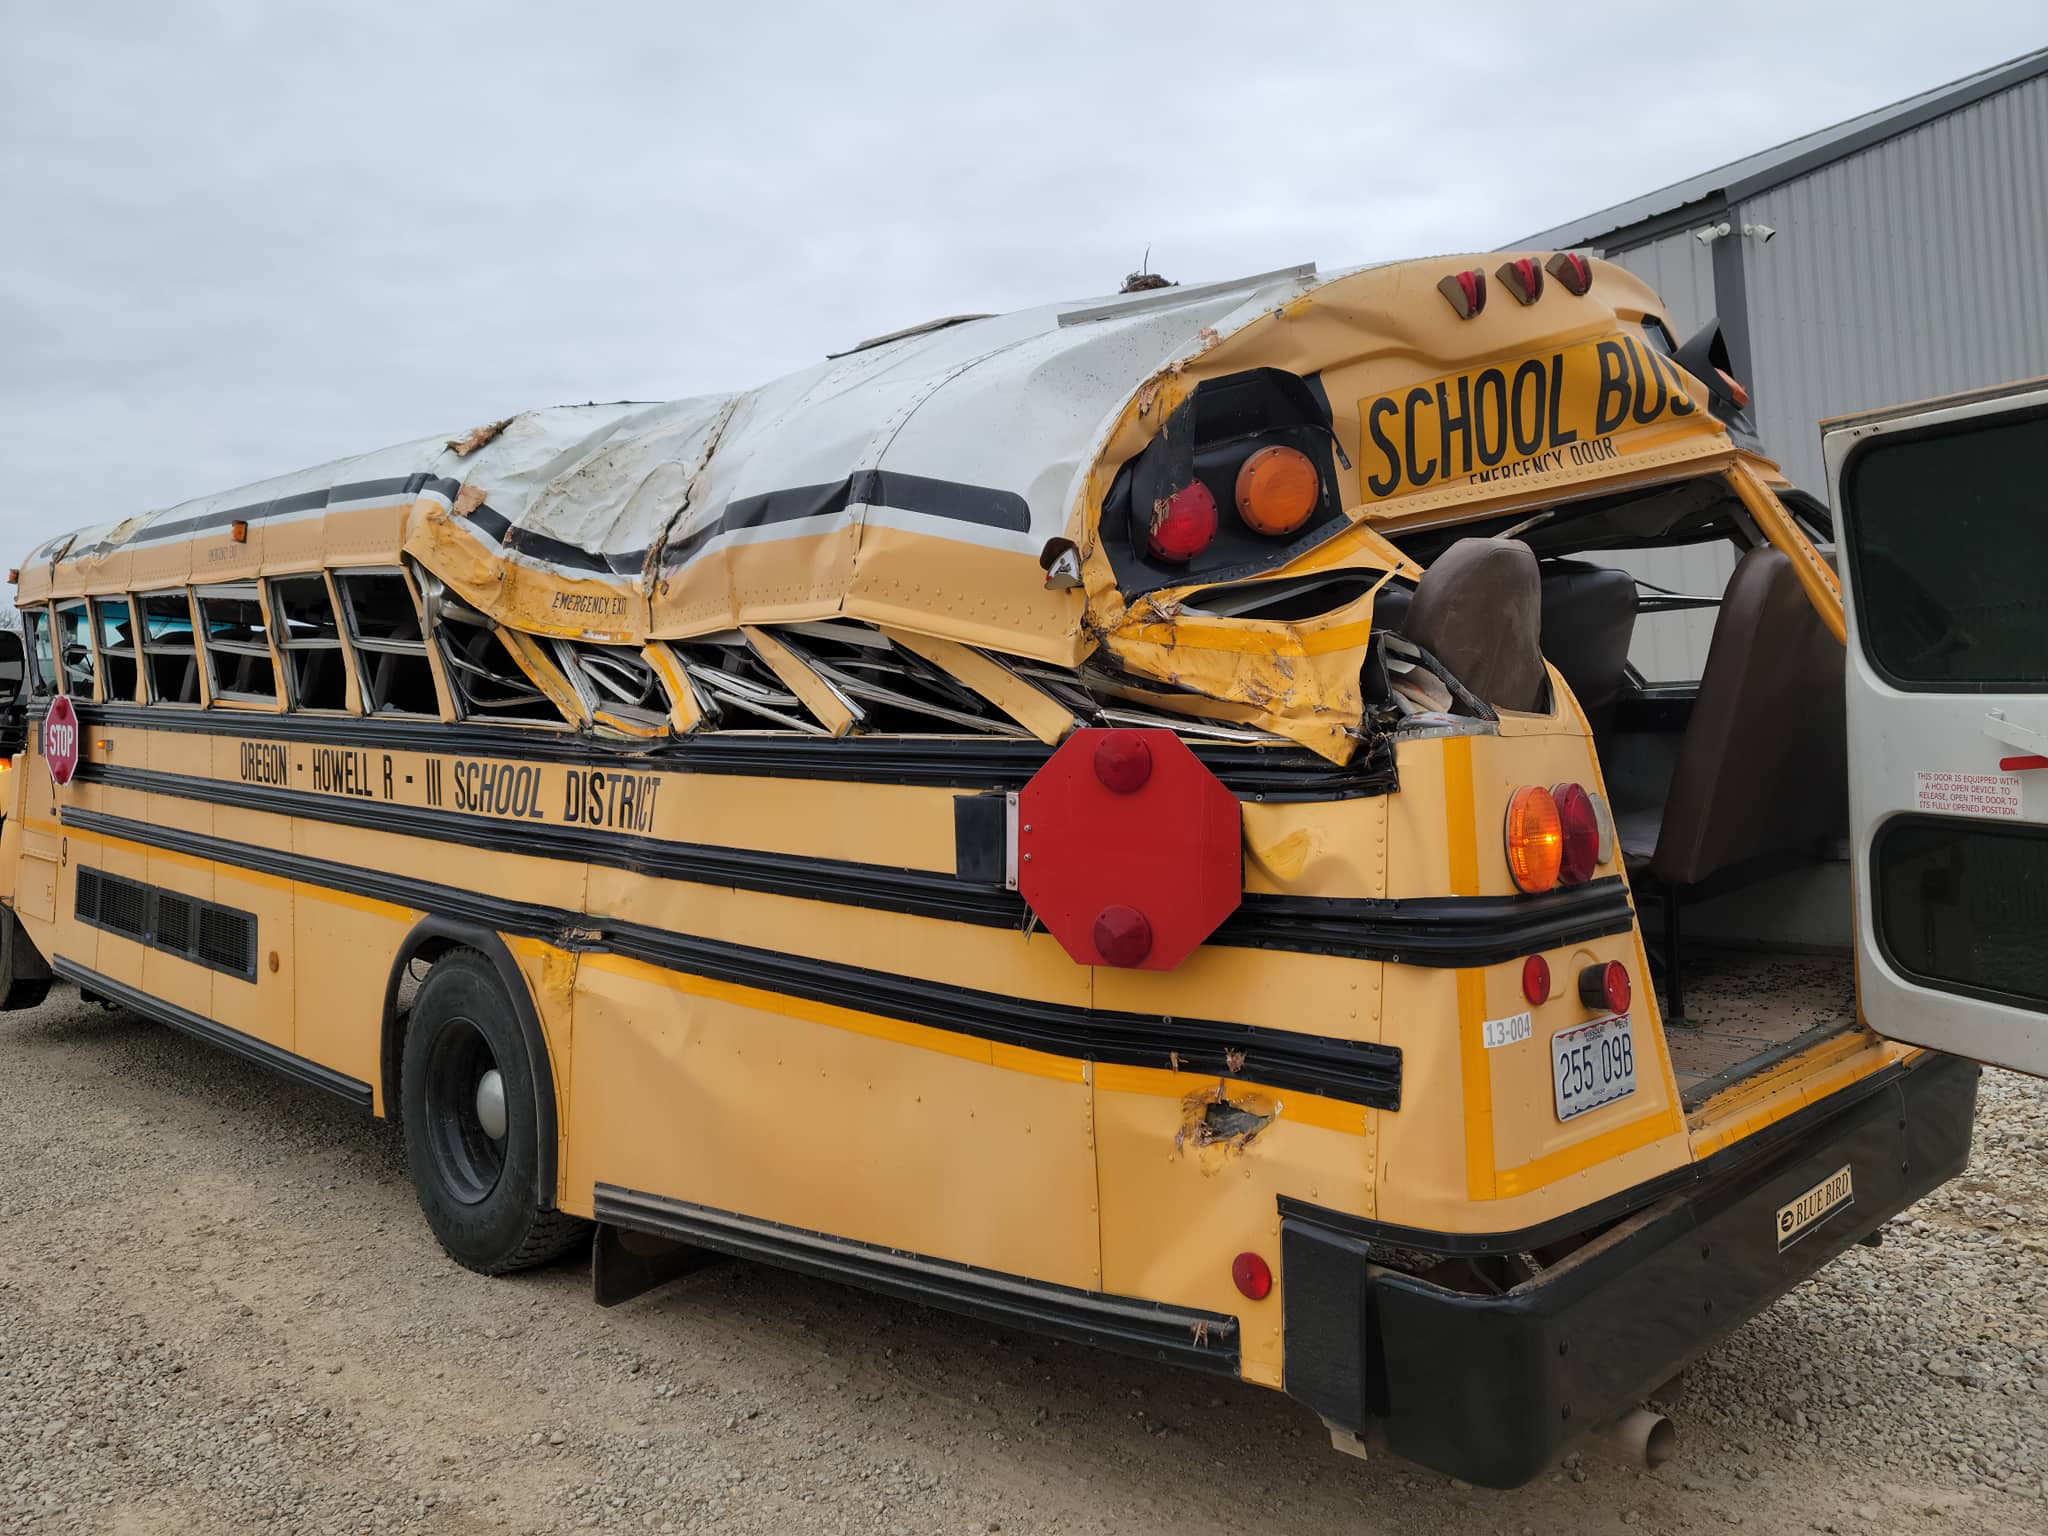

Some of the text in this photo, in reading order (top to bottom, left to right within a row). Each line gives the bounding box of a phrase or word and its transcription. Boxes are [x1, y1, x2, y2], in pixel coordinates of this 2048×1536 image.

[1368, 336, 1695, 497] SCHOOL BUS
[1570, 437, 1617, 466] DOOR
[552, 591, 626, 615] EMERGENCY EXIT
[50, 724, 73, 758] STOP
[240, 741, 288, 785] OREGON
[312, 748, 373, 797] HOWELL
[383, 754, 394, 799] R
[426, 758, 442, 806] III
[454, 761, 544, 818] SCHOOL
[563, 770, 661, 832] DISTRICT
[1918, 772, 2019, 785] THIS DOOR IS EQUIPPED WITH
[1951, 784, 1969, 792] OPEN
[2000, 787, 2011, 795] TO
[1919, 800, 1931, 808] ITS
[1931, 801, 1951, 810] FULLY
[1952, 803, 1980, 812] OPENED
[1950, 793, 1968, 802] OPEN
[1970, 794, 1984, 803] THE
[1985, 796, 2006, 805] DOOR
[2008, 797, 2018, 806] TO
[61, 837, 68, 867] 9
[1486, 1014, 1530, 1046] 13-004
[1560, 1033, 1633, 1099] 255 09B
[1796, 1172, 1849, 1226] BLUE BIRD
